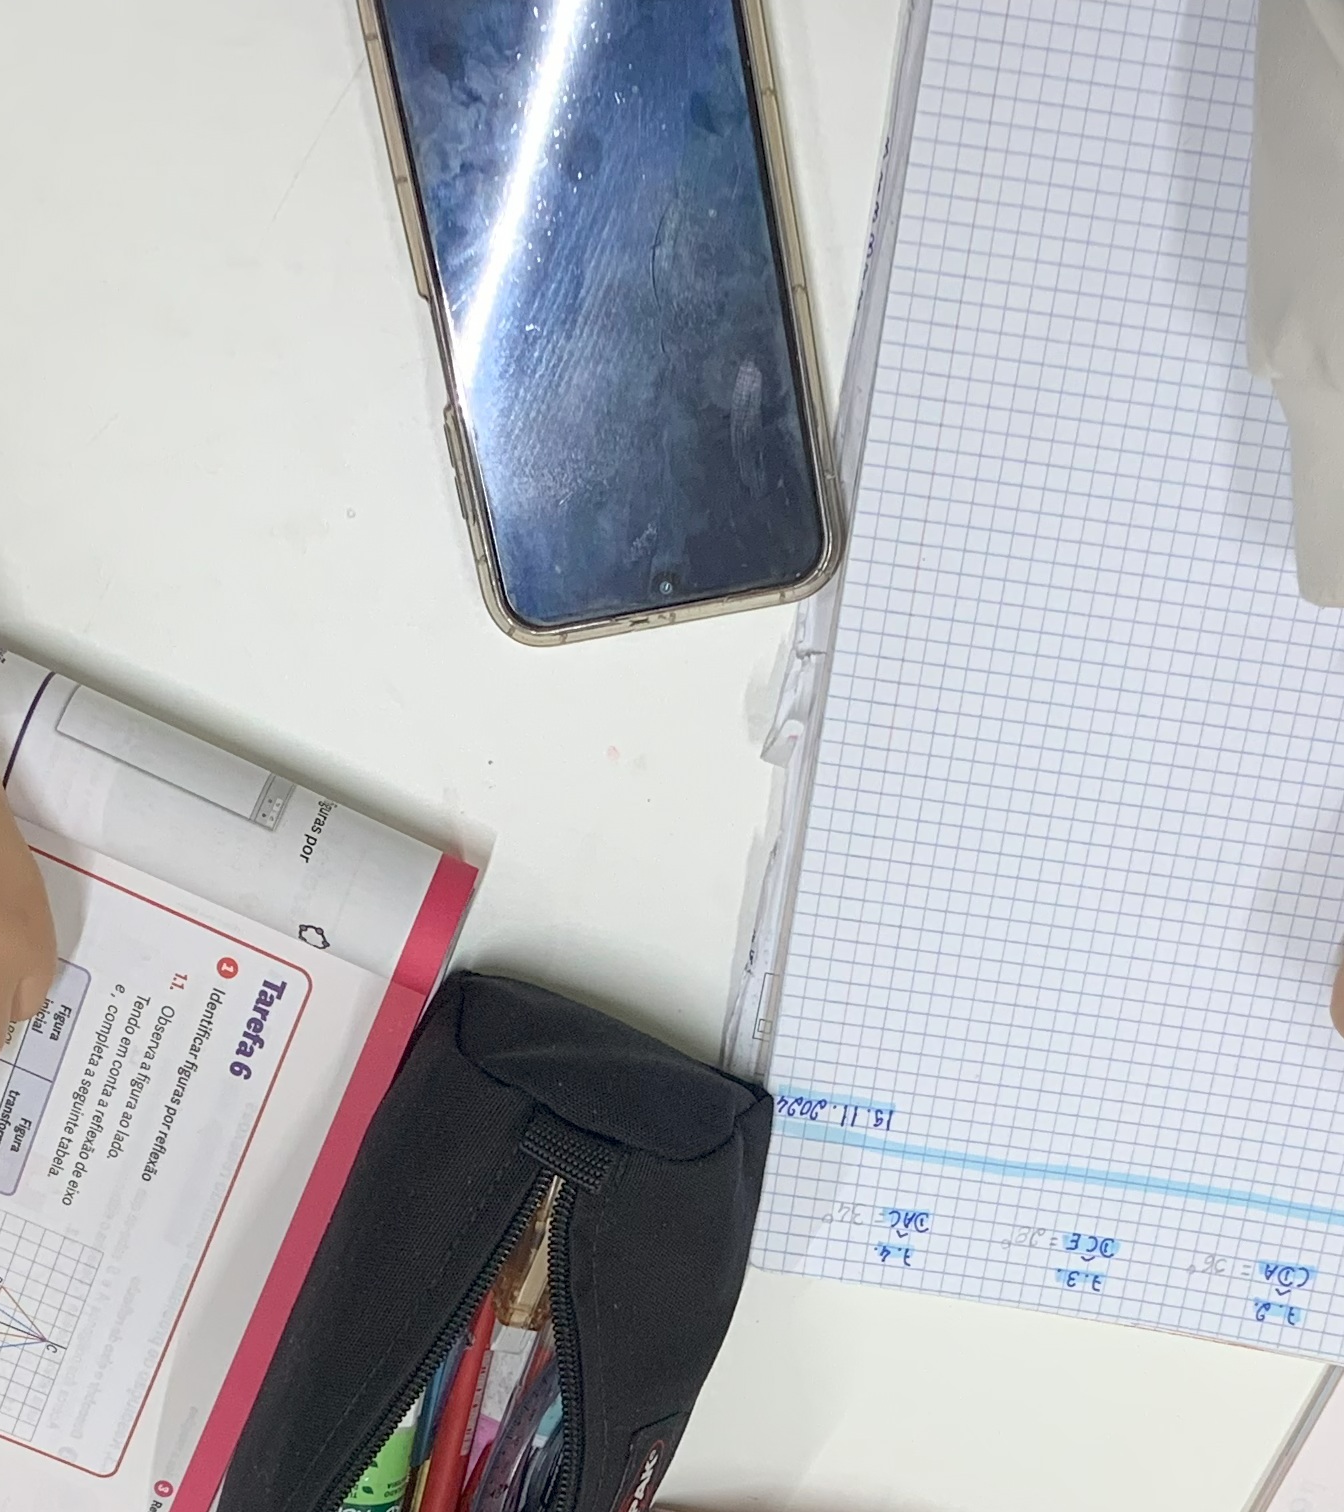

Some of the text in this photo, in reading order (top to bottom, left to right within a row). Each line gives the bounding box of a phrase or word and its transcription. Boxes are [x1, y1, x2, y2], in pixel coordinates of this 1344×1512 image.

[299, 833, 317, 863] por
[169, 972, 187, 989] 1.1.
[28, 995, 52, 1035] inicial
[49, 1004, 72, 1041] Figura
[87, 1004, 118, 1066] completa
[229, 979, 287, 1080] Tarefa 6
[83, 1067, 95, 1077] a
[106, 1005, 175, 1158] Observa a figura ao lado.
[141, 987, 226, 1181] Identificar figuras por reflexão
[61, 995, 151, 1206] Tendo em conta a reflexão de eixo
[63, 1078, 91, 1134] seguinte
[9, 1117, 32, 1152] Figura
[46, 1136, 73, 1177] tabela.
